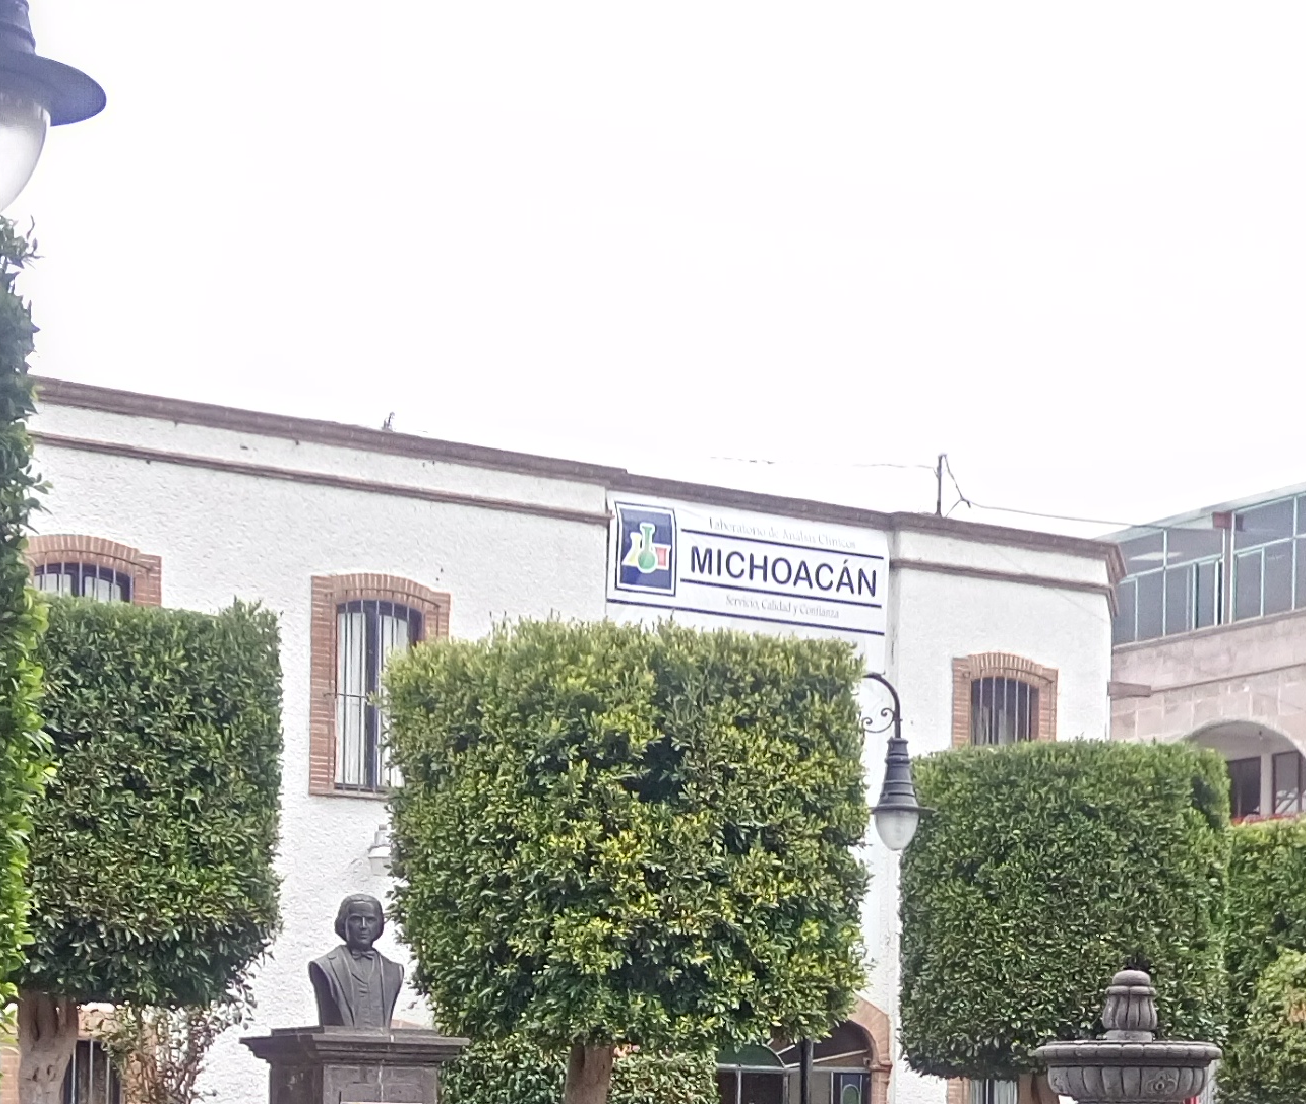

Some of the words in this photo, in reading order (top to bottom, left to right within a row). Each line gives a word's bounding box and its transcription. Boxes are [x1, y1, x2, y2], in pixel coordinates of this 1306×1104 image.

[768, 526, 778, 539] de
[690, 546, 877, 598] MICHOACÁN
[761, 599, 791, 612] Calidad
